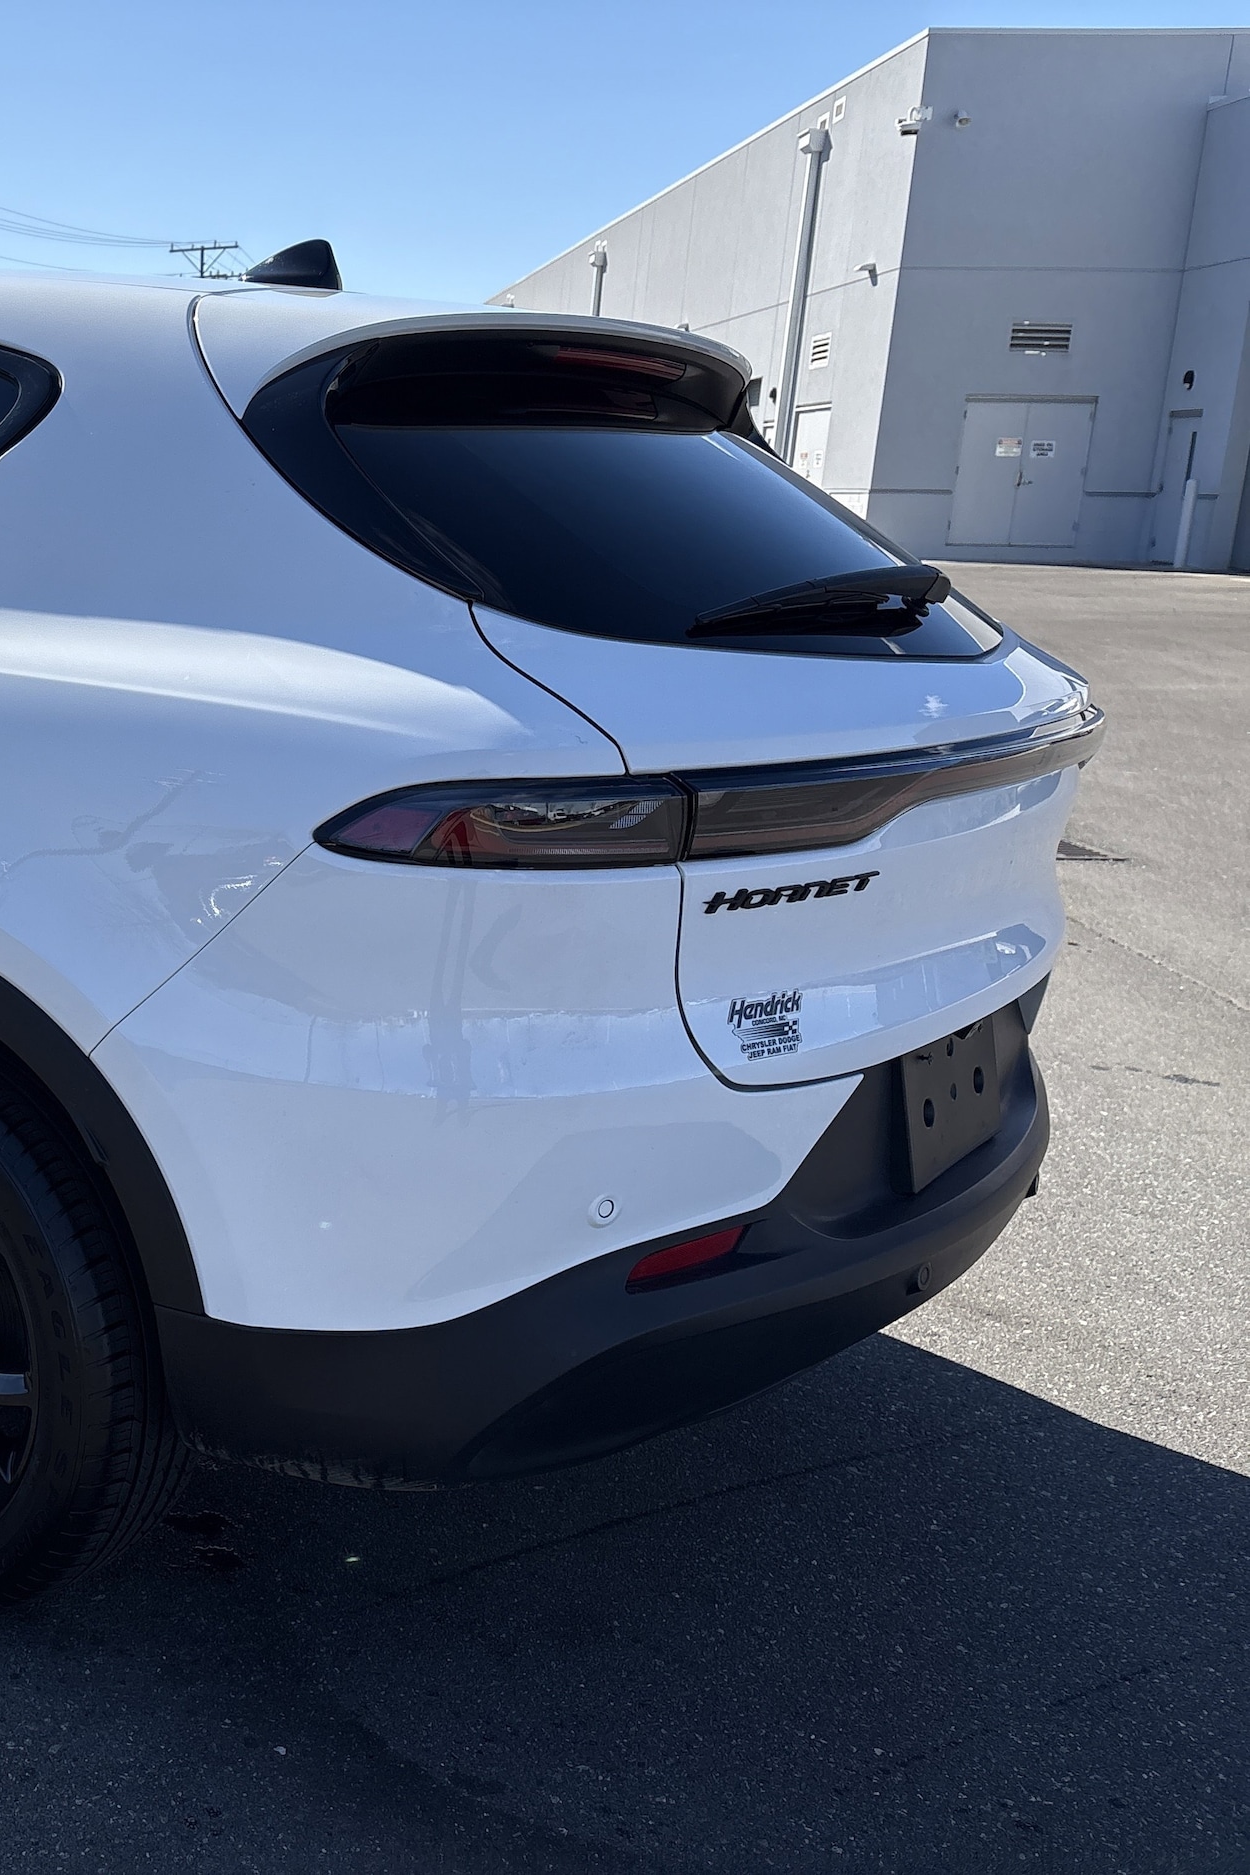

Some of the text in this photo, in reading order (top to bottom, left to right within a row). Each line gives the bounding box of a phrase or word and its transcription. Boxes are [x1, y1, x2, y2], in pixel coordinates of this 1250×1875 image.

[702, 870, 881, 915] HORNET
[727, 989, 802, 1029] Hendrick
[741, 1034, 801, 1052] CHRYSLER DODGE
[749, 1043, 797, 1059] JEEP RAM FIAT
